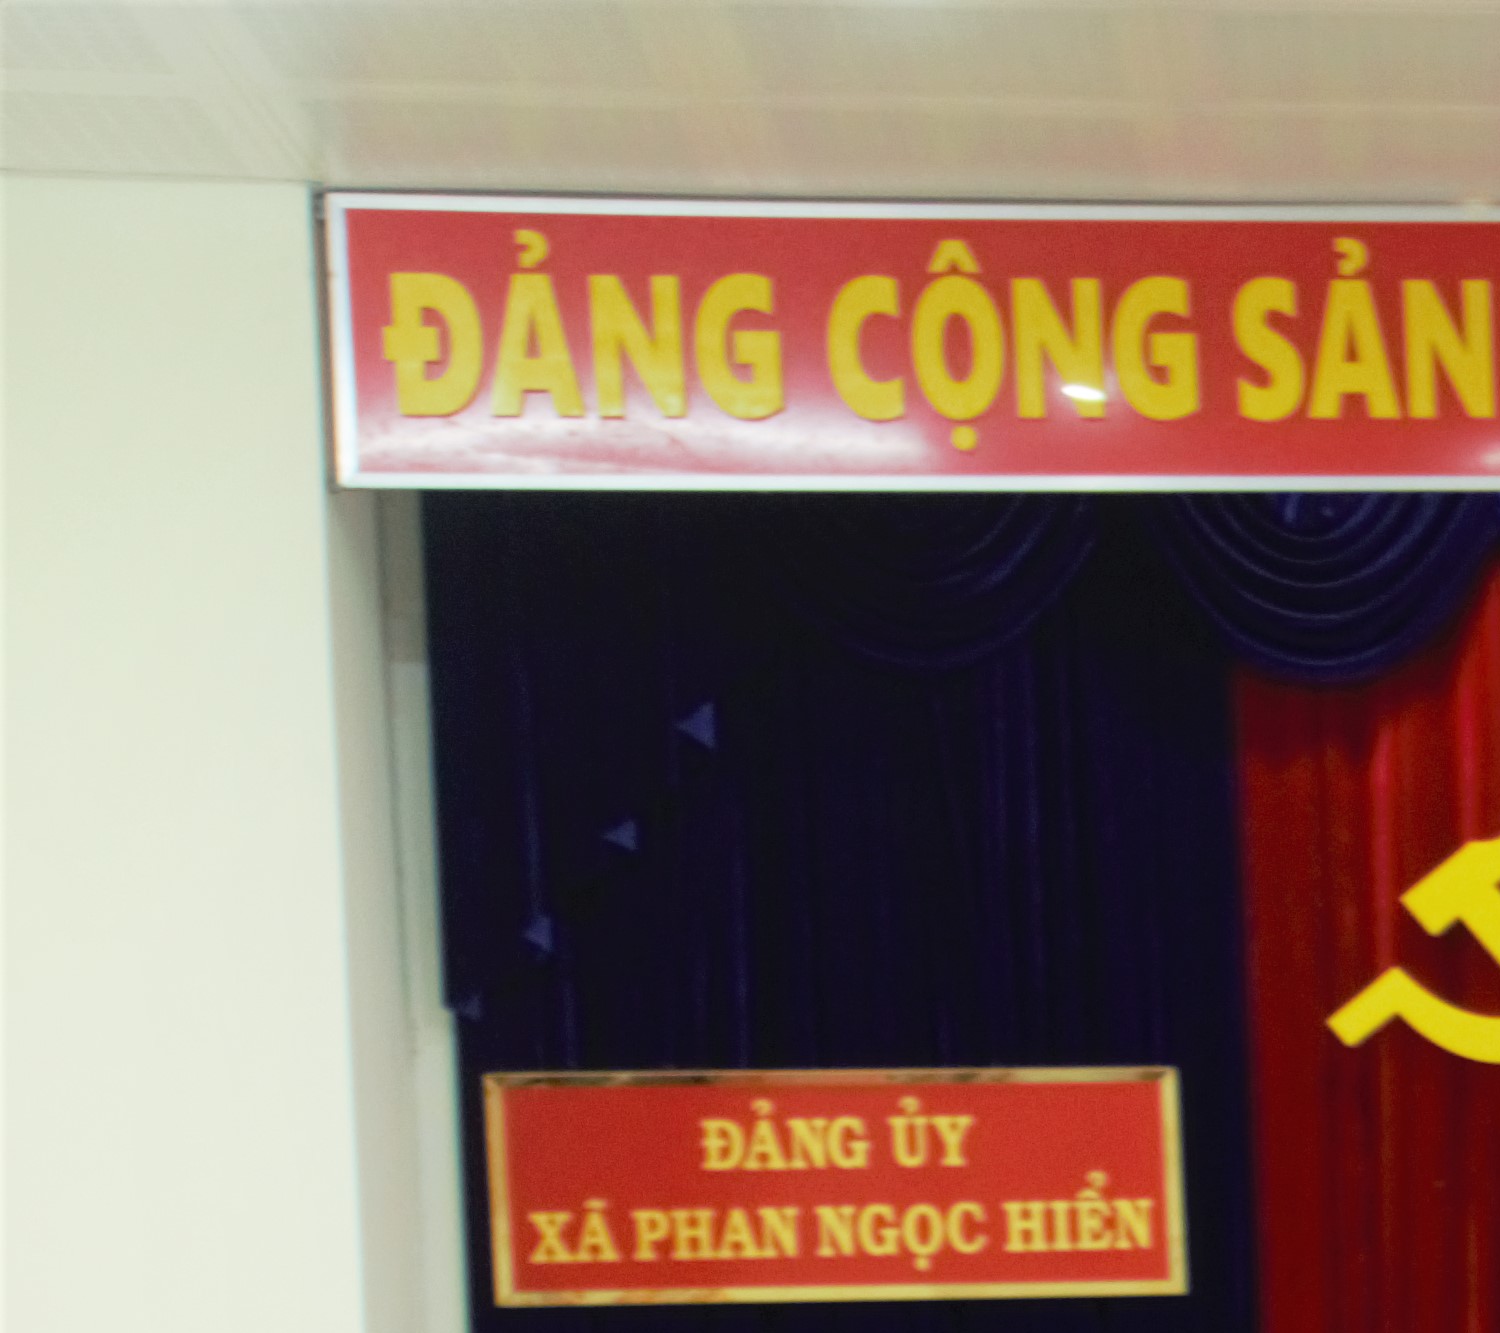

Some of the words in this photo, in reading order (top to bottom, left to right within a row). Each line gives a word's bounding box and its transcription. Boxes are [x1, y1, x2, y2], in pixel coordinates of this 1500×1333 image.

[384, 230, 782, 418] ĐẢNG
[826, 240, 1200, 451] CỘNG
[1234, 238, 1495, 421] SẢN
[702, 1099, 870, 1171] ĐẢNG
[888, 1096, 973, 1168] ỦY
[529, 1199, 620, 1264] XÃ
[633, 1206, 799, 1261] PHAN
[815, 1201, 986, 1270] NGỌC
[1002, 1170, 1153, 1253] HIỂN
